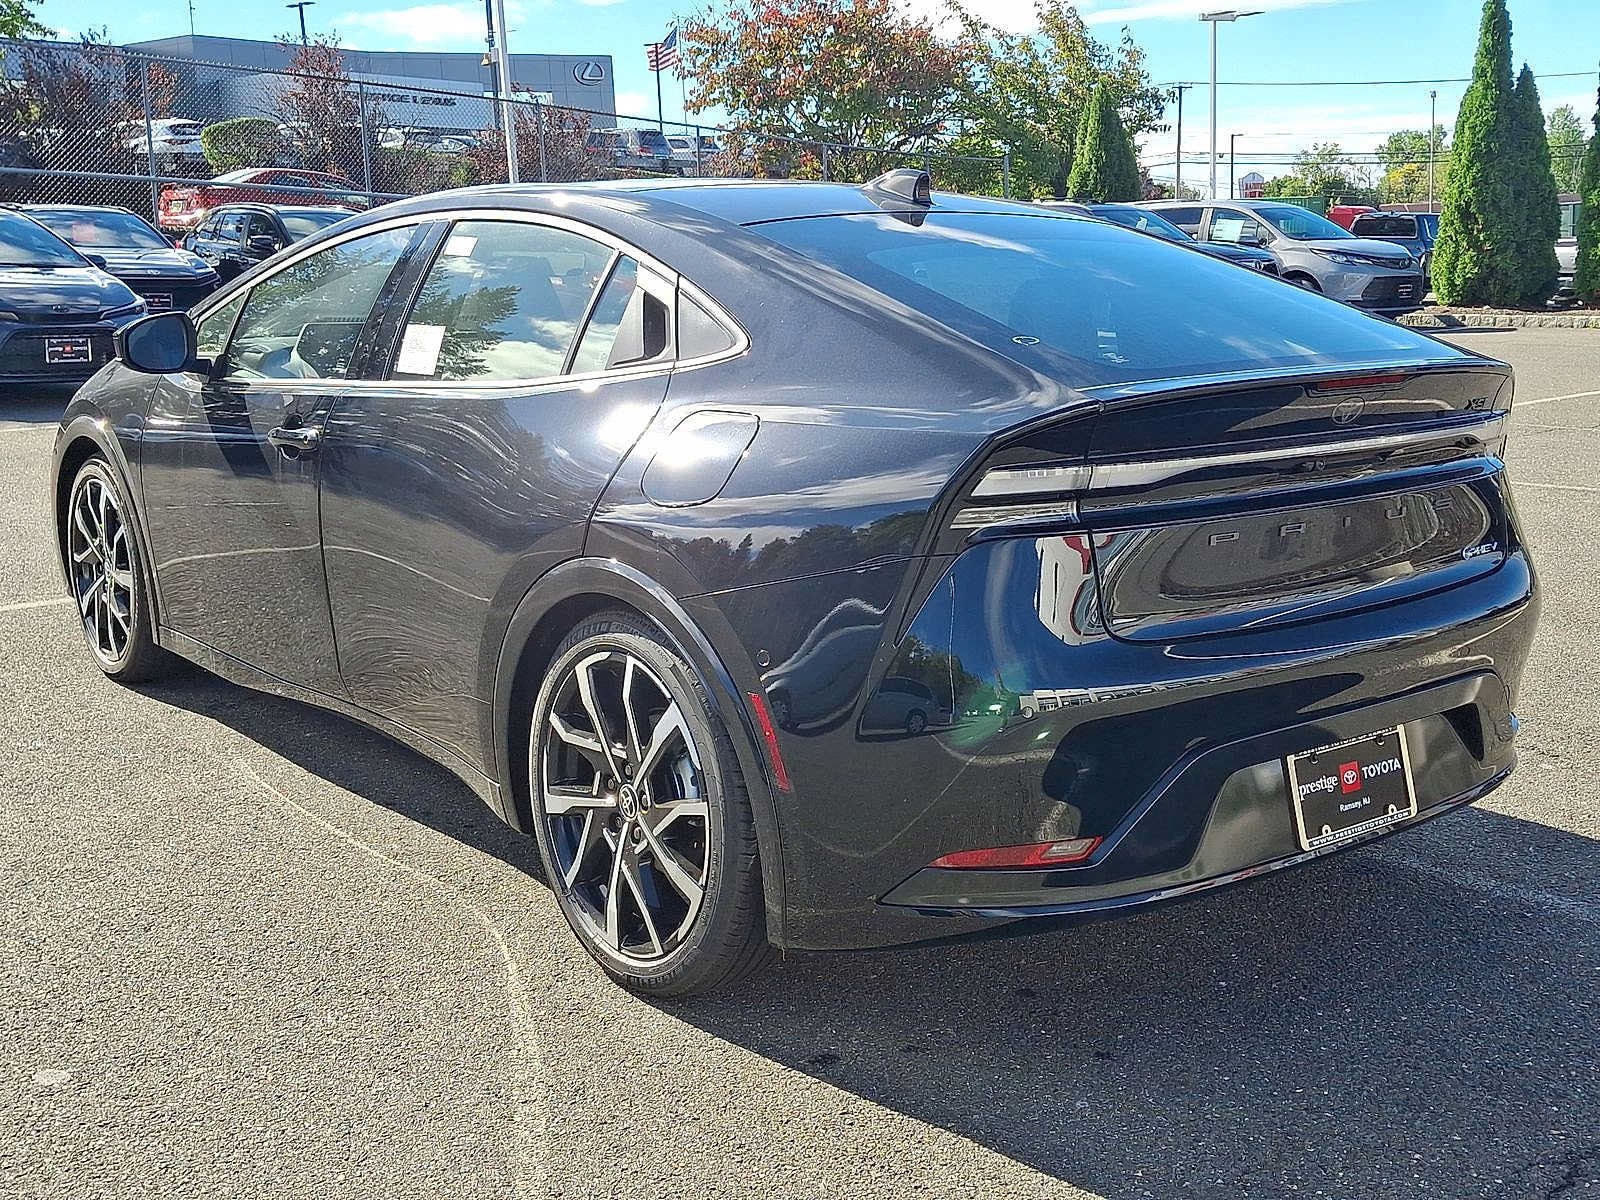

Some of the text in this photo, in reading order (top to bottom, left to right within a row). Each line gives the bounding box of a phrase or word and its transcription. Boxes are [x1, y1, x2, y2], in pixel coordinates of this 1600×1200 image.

[1299, 758, 1402, 801] prestige TOYOTA
[1340, 796, 1371, 812] Ramsey, NJ
